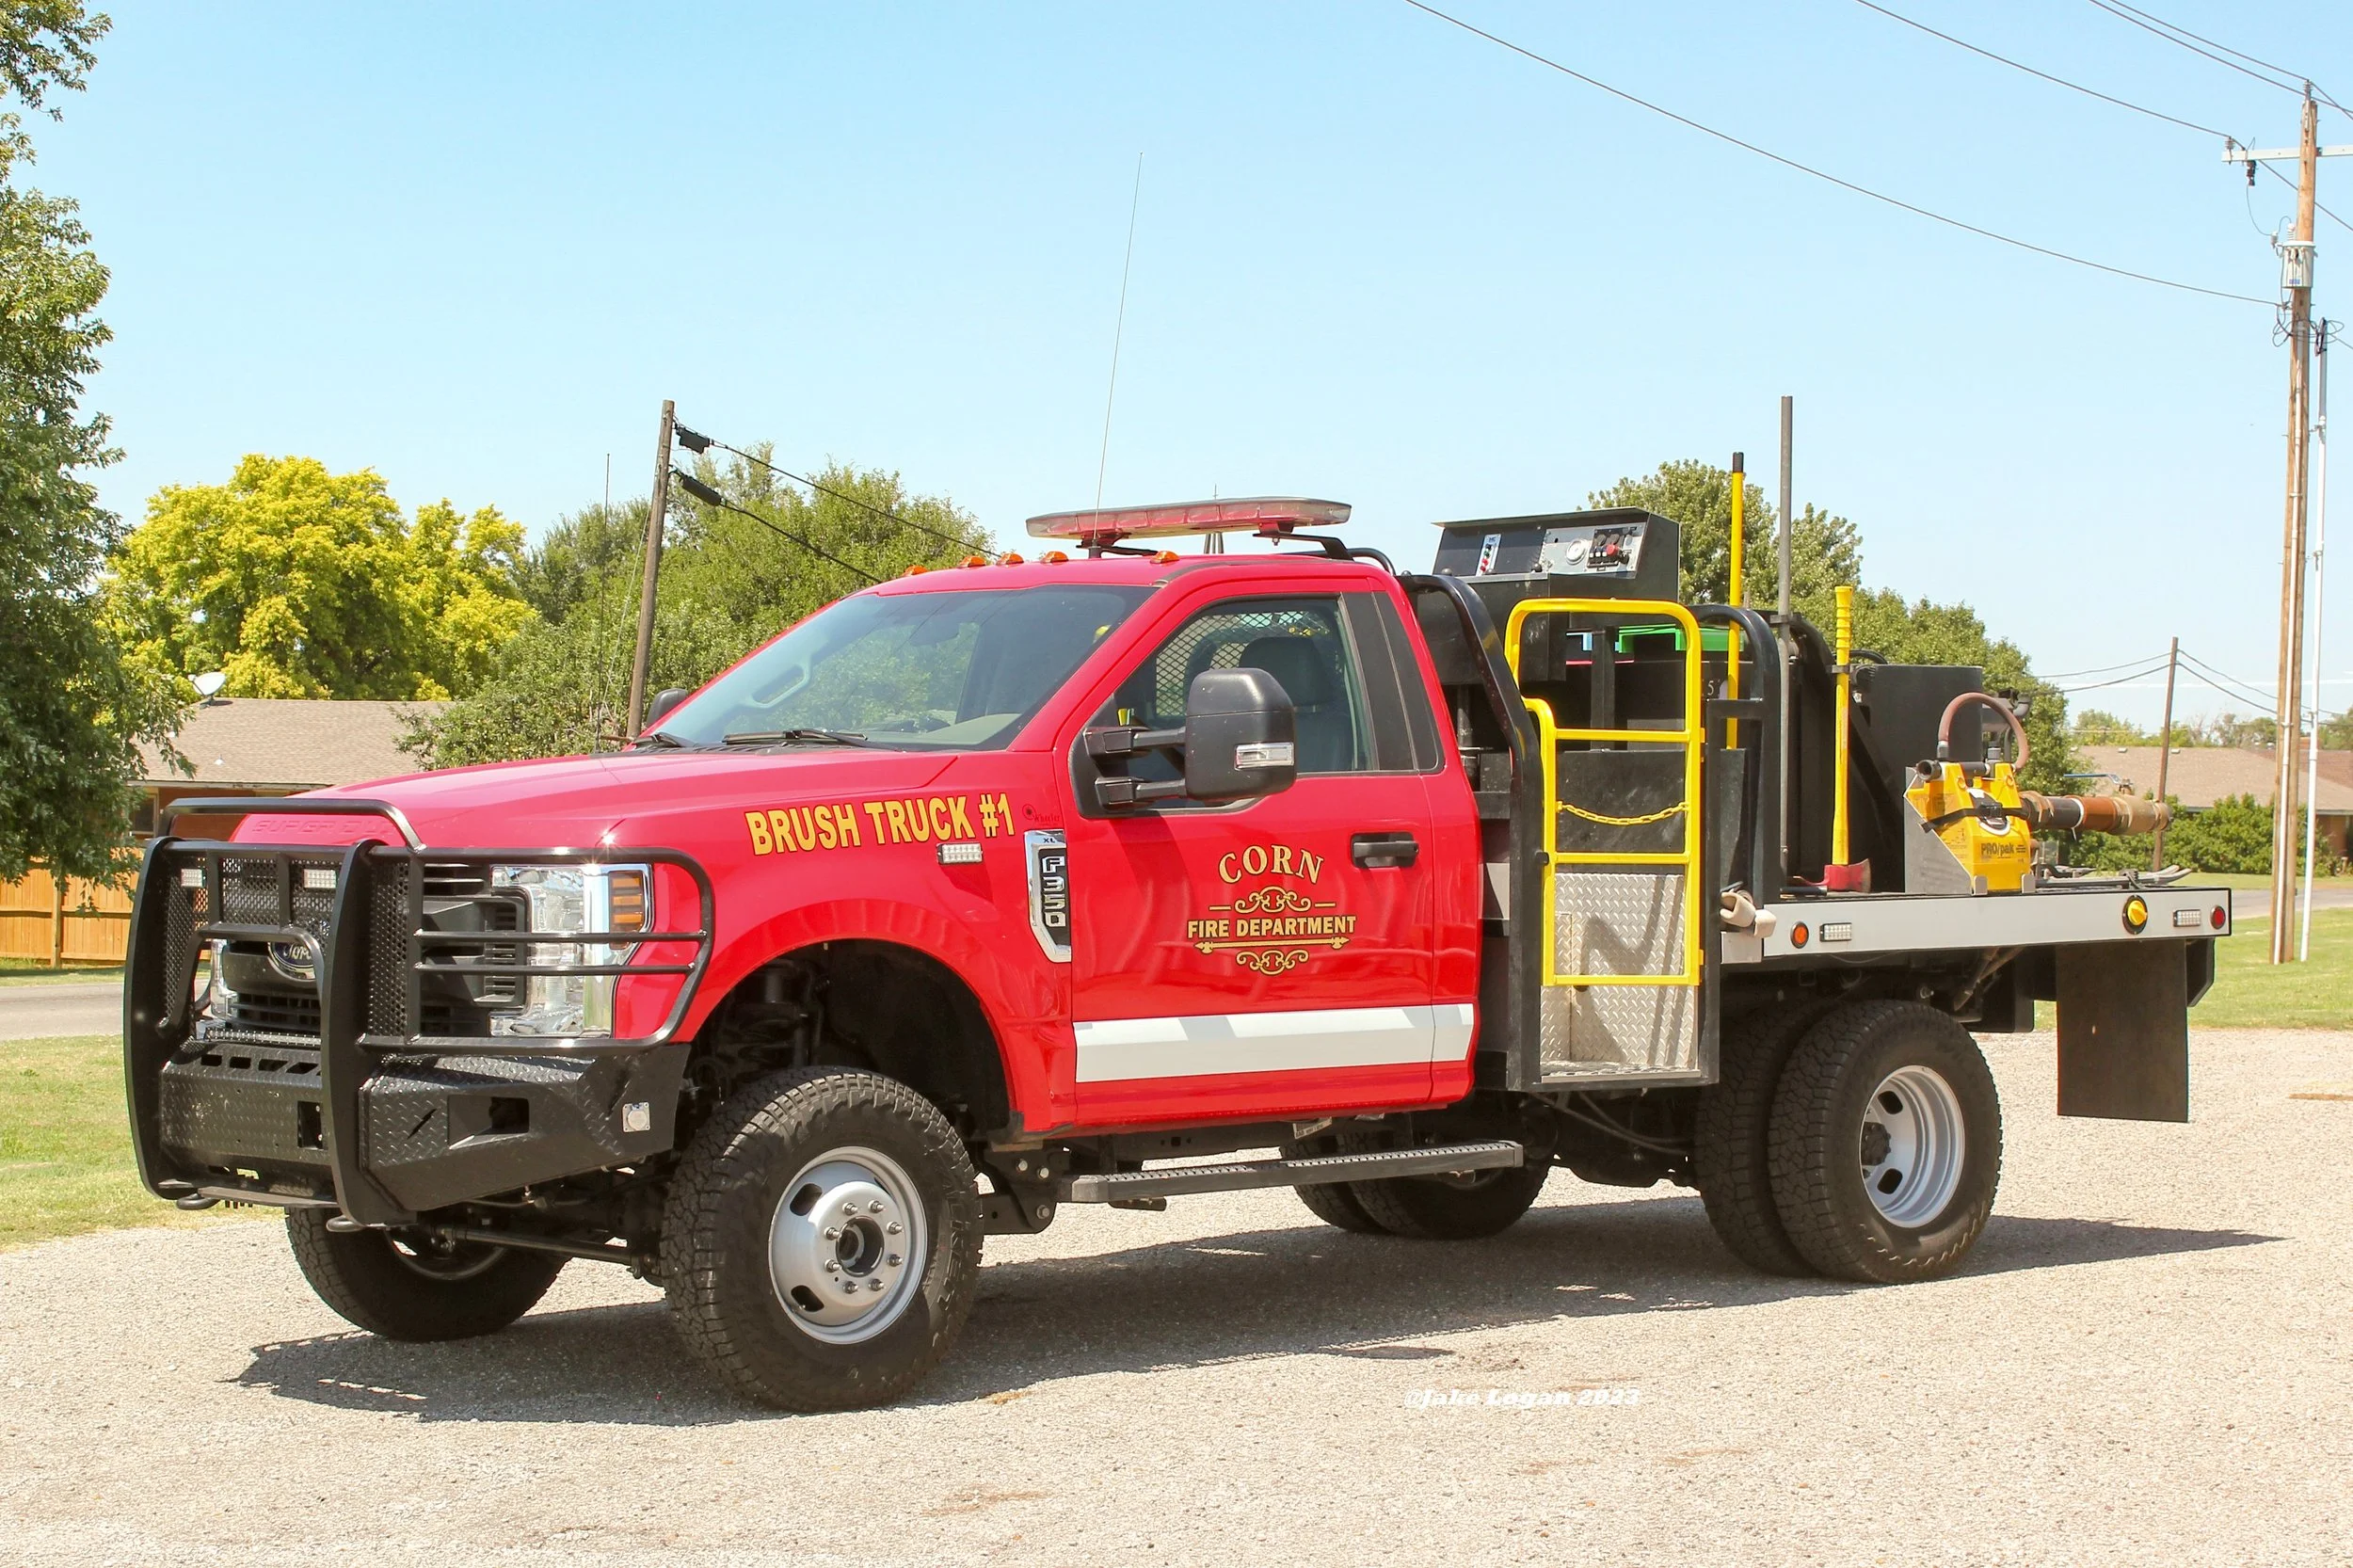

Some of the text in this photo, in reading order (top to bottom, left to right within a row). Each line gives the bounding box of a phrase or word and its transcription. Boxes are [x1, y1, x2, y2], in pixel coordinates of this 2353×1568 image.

[744, 792, 1016, 856] BRUSH TRUCK #1
[1218, 844, 1324, 884] CORN
[1187, 915, 1357, 939] FIRE DEPARTMENT
